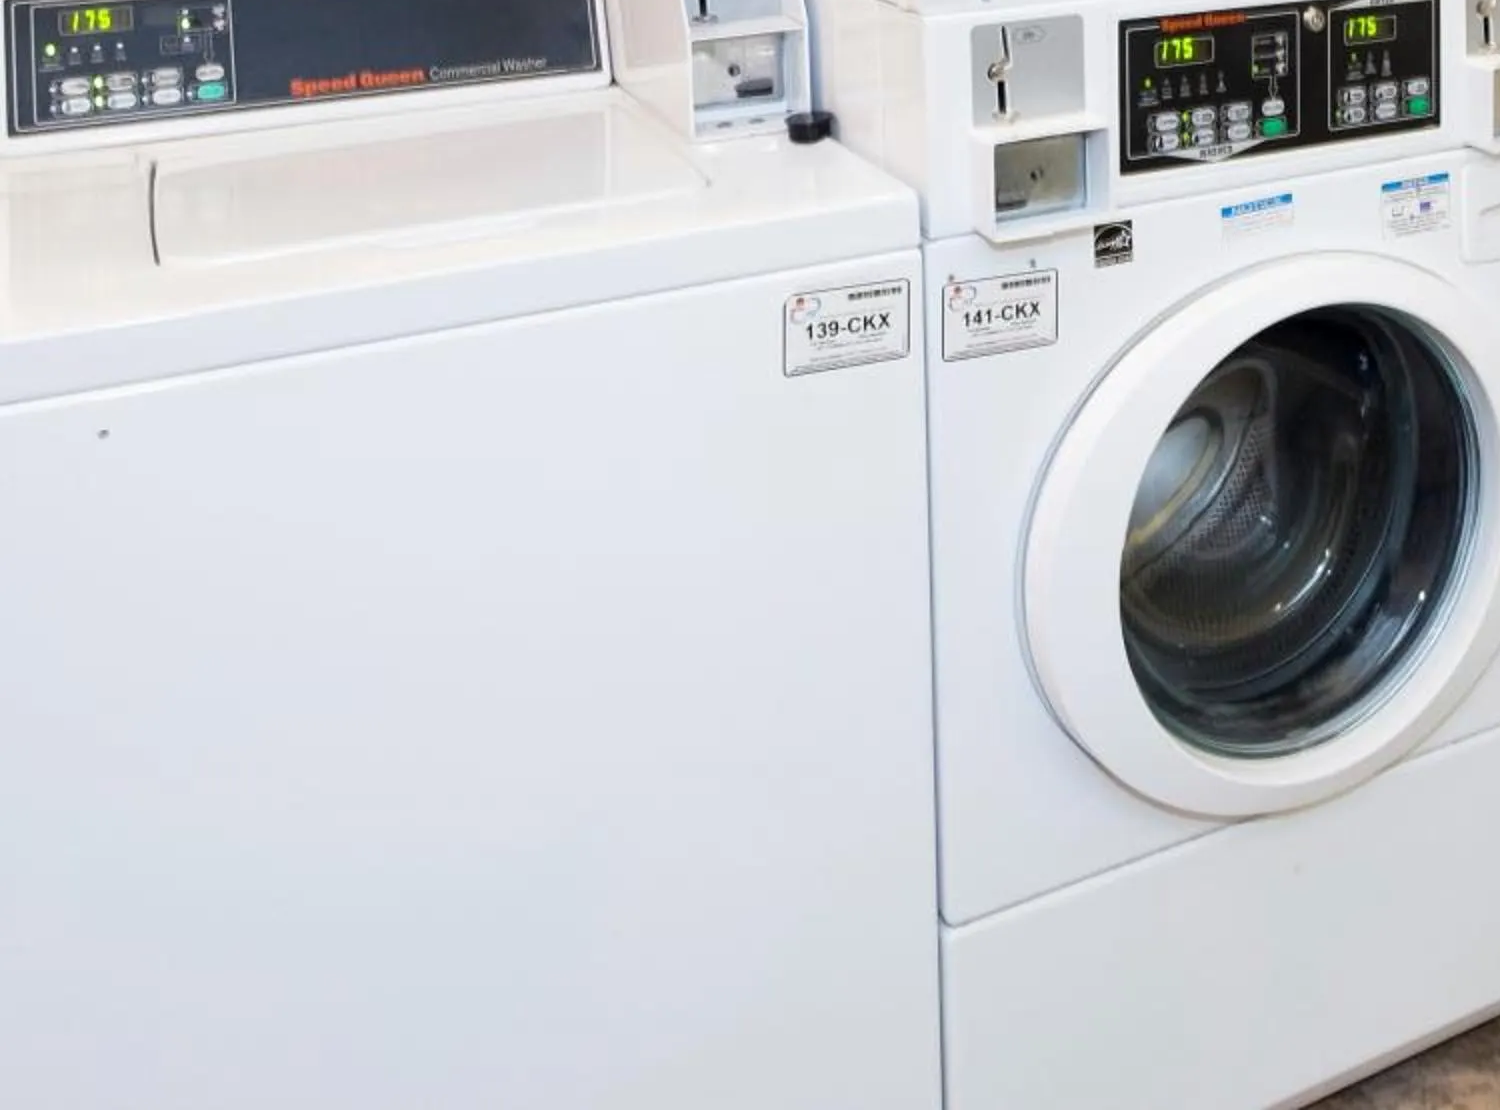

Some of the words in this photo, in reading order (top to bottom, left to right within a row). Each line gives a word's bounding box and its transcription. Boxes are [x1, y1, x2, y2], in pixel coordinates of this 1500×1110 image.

[70, 8, 111, 33] 175
[1348, 15, 1377, 39] 175
[1162, 37, 1193, 61] 175
[290, 72, 357, 99] Speed
[359, 66, 427, 89] Queen
[429, 60, 502, 82] Commercial
[503, 56, 548, 74] Washer
[805, 312, 892, 340] 139-CKX
[963, 301, 1041, 328] 141-CKX
